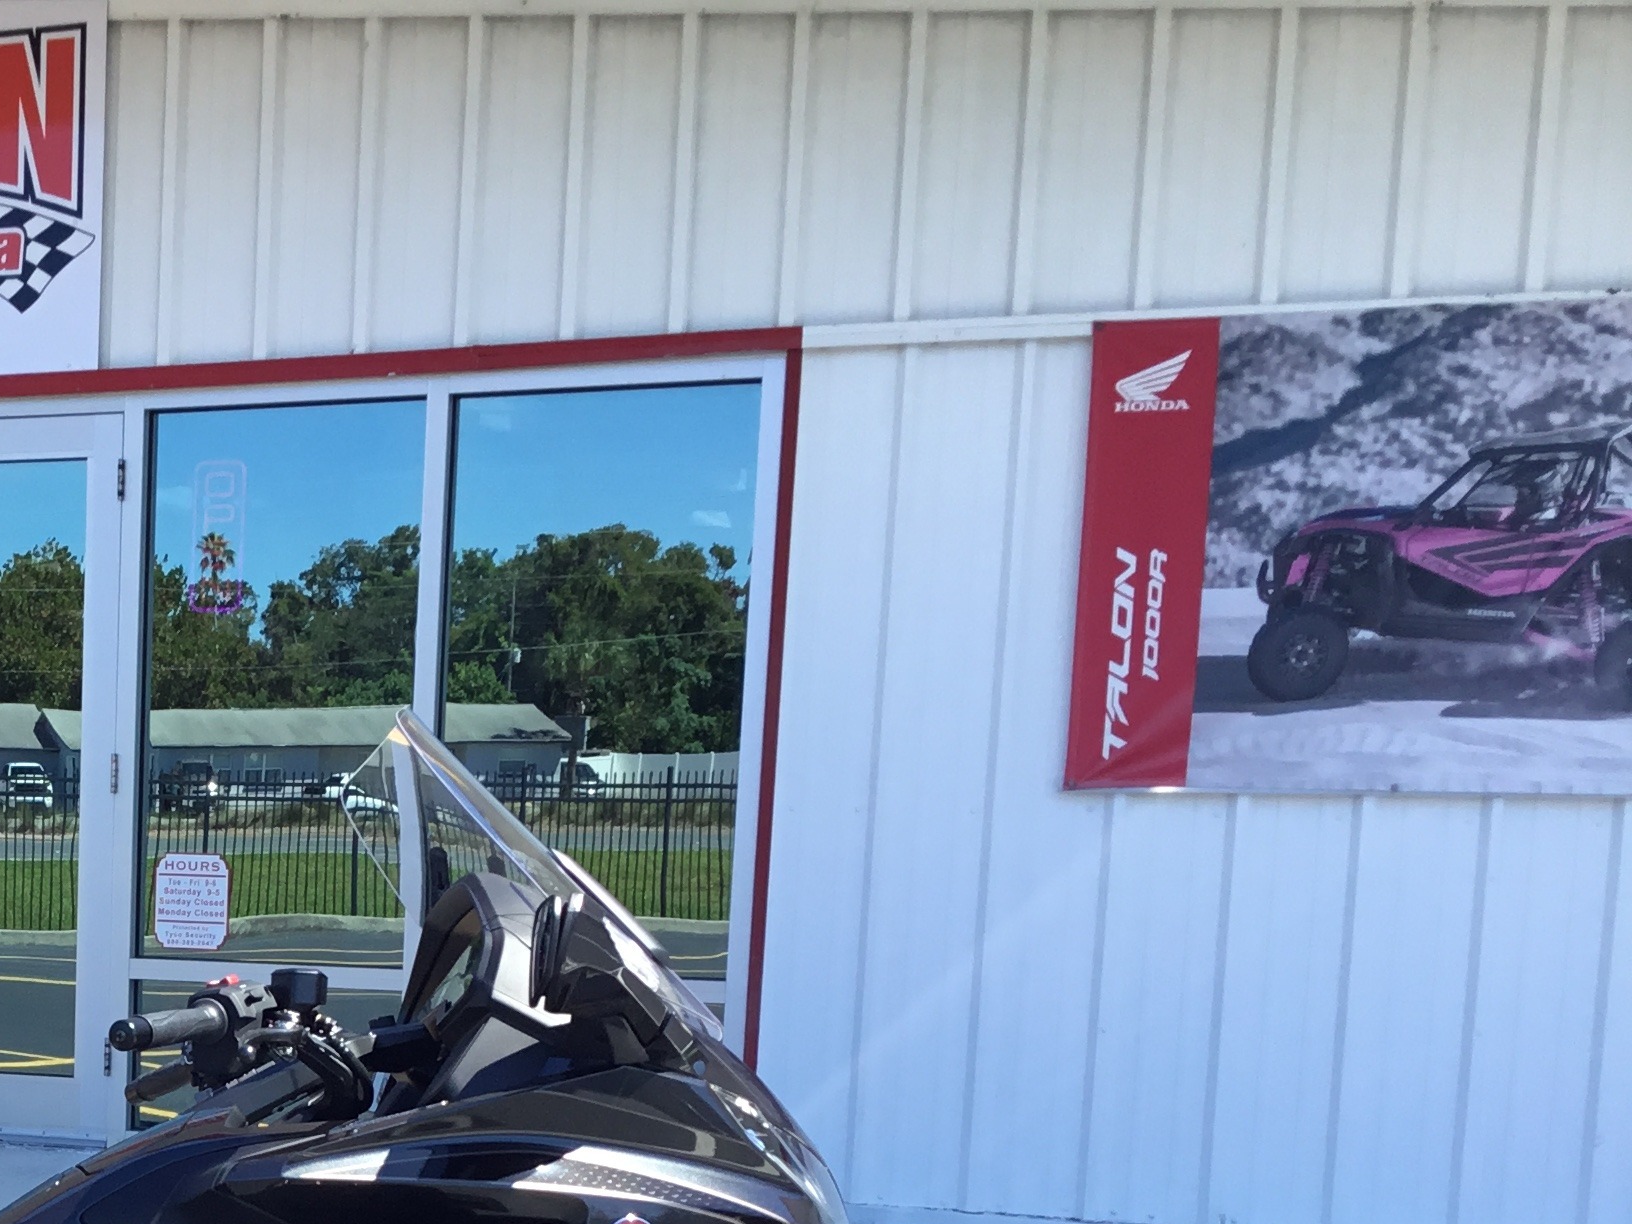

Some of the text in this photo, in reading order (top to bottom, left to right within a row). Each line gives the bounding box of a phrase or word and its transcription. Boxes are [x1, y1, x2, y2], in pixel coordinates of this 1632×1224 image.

[1114, 399, 1190, 413] HONDA
[1141, 548, 1168, 681] 1000R
[1101, 547, 1137, 760] TALON
[164, 860, 221, 872] HOURS
[168, 878, 181, 886] Tue
[189, 879, 200, 887] Fri
[163, 886, 202, 898] Saturday
[159, 897, 225, 908] Sunday Closed
[158, 907, 225, 918] Monday Closed
[185, 931, 217, 940] Security
